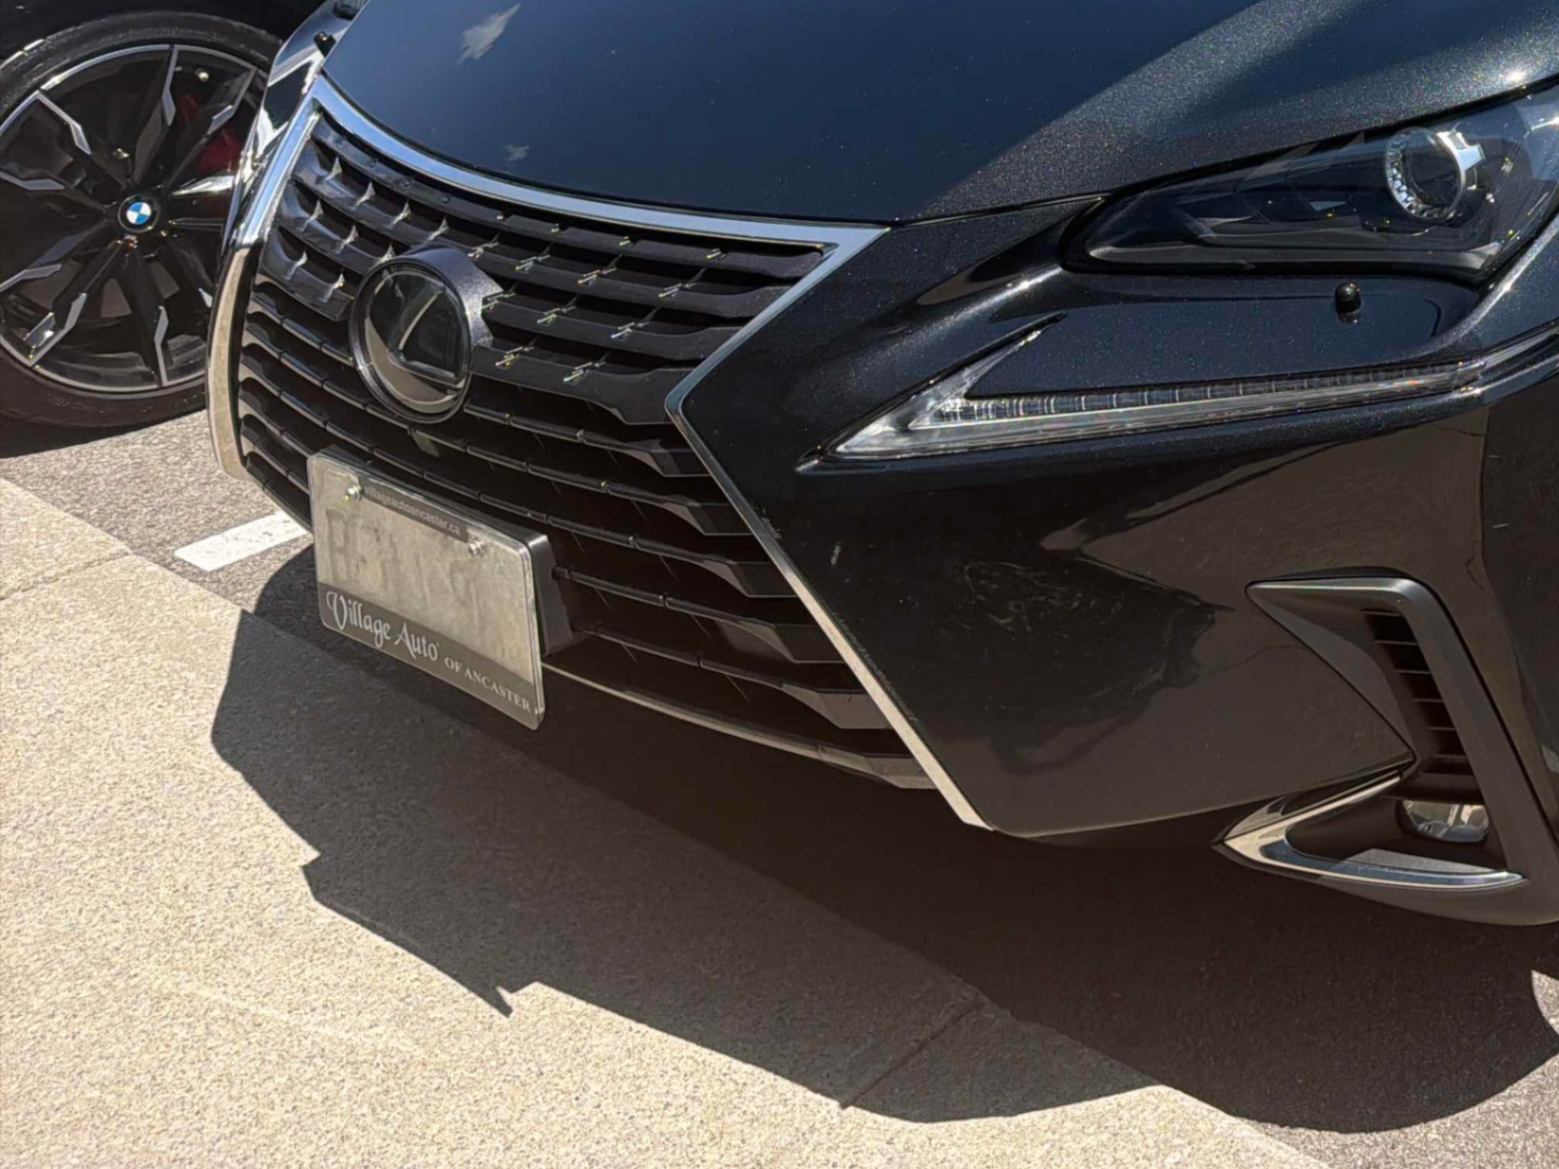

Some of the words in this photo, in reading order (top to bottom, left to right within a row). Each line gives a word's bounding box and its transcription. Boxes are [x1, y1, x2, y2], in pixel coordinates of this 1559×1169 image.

[327, 591, 392, 648] Village
[394, 622, 438, 661] Auto
[444, 656, 463, 673] OF
[464, 667, 532, 713] ANCASTER
